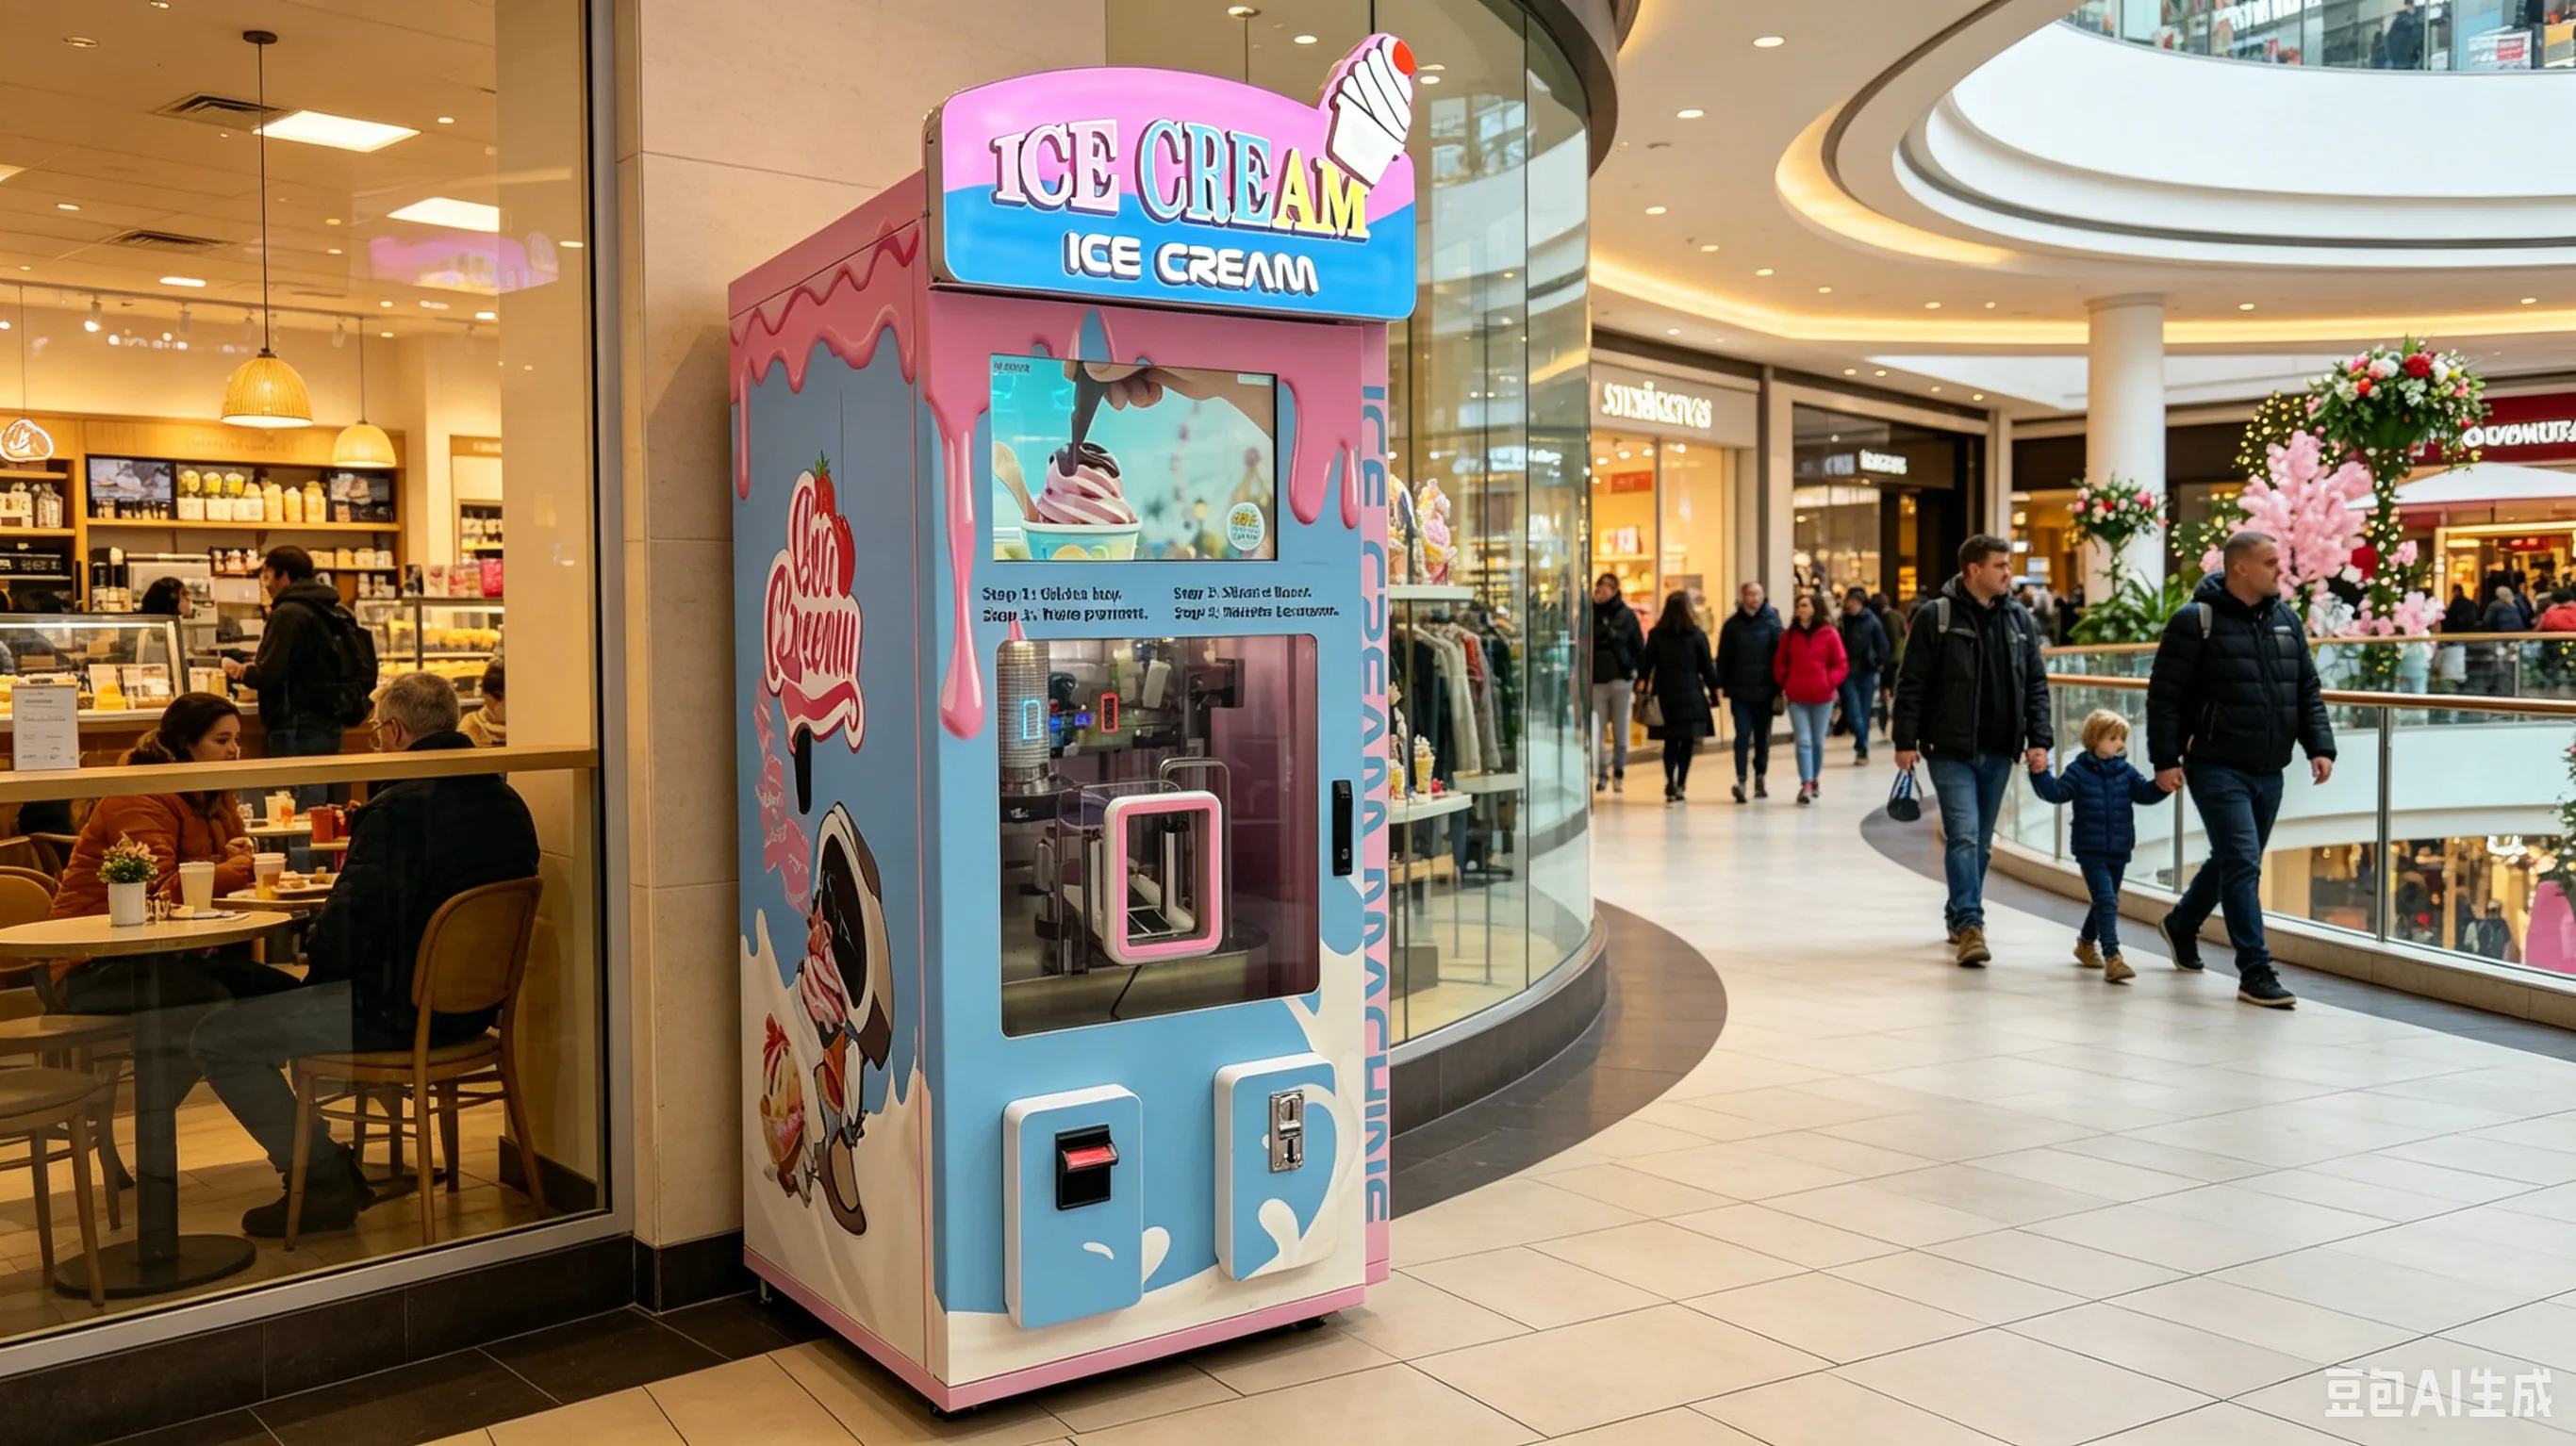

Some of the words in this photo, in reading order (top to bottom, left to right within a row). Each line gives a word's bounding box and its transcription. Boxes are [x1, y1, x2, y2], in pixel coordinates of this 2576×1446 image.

[991, 119, 1119, 216] ICE
[1135, 119, 1371, 242] CREAM
[1064, 231, 1142, 280] ICE
[1154, 241, 1319, 295] CREAM
